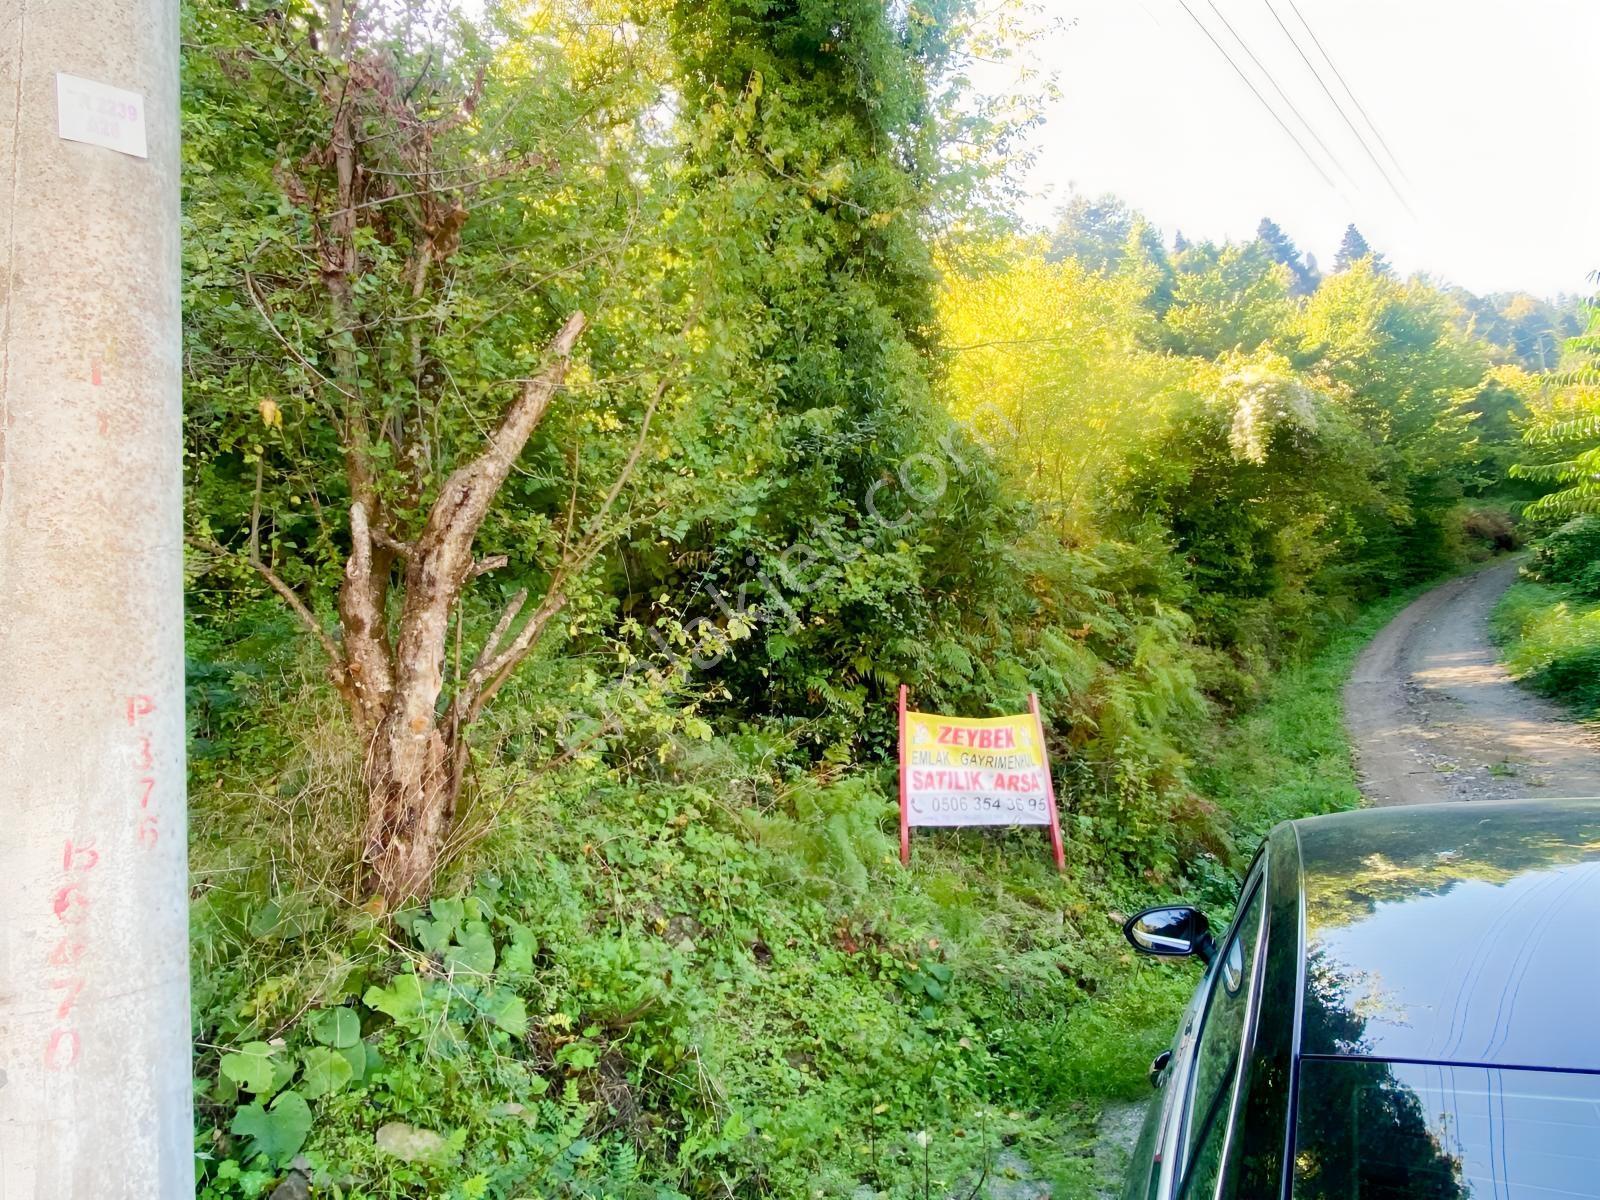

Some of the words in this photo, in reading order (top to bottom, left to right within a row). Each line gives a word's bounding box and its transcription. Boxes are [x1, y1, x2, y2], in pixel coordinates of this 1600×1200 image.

[937, 725, 1016, 749] ZEYBEK
[911, 750, 950, 766] EMLAK
[912, 771, 984, 791] SATILIK
[932, 797, 968, 812] 0506
[974, 796, 1001, 811] 354
